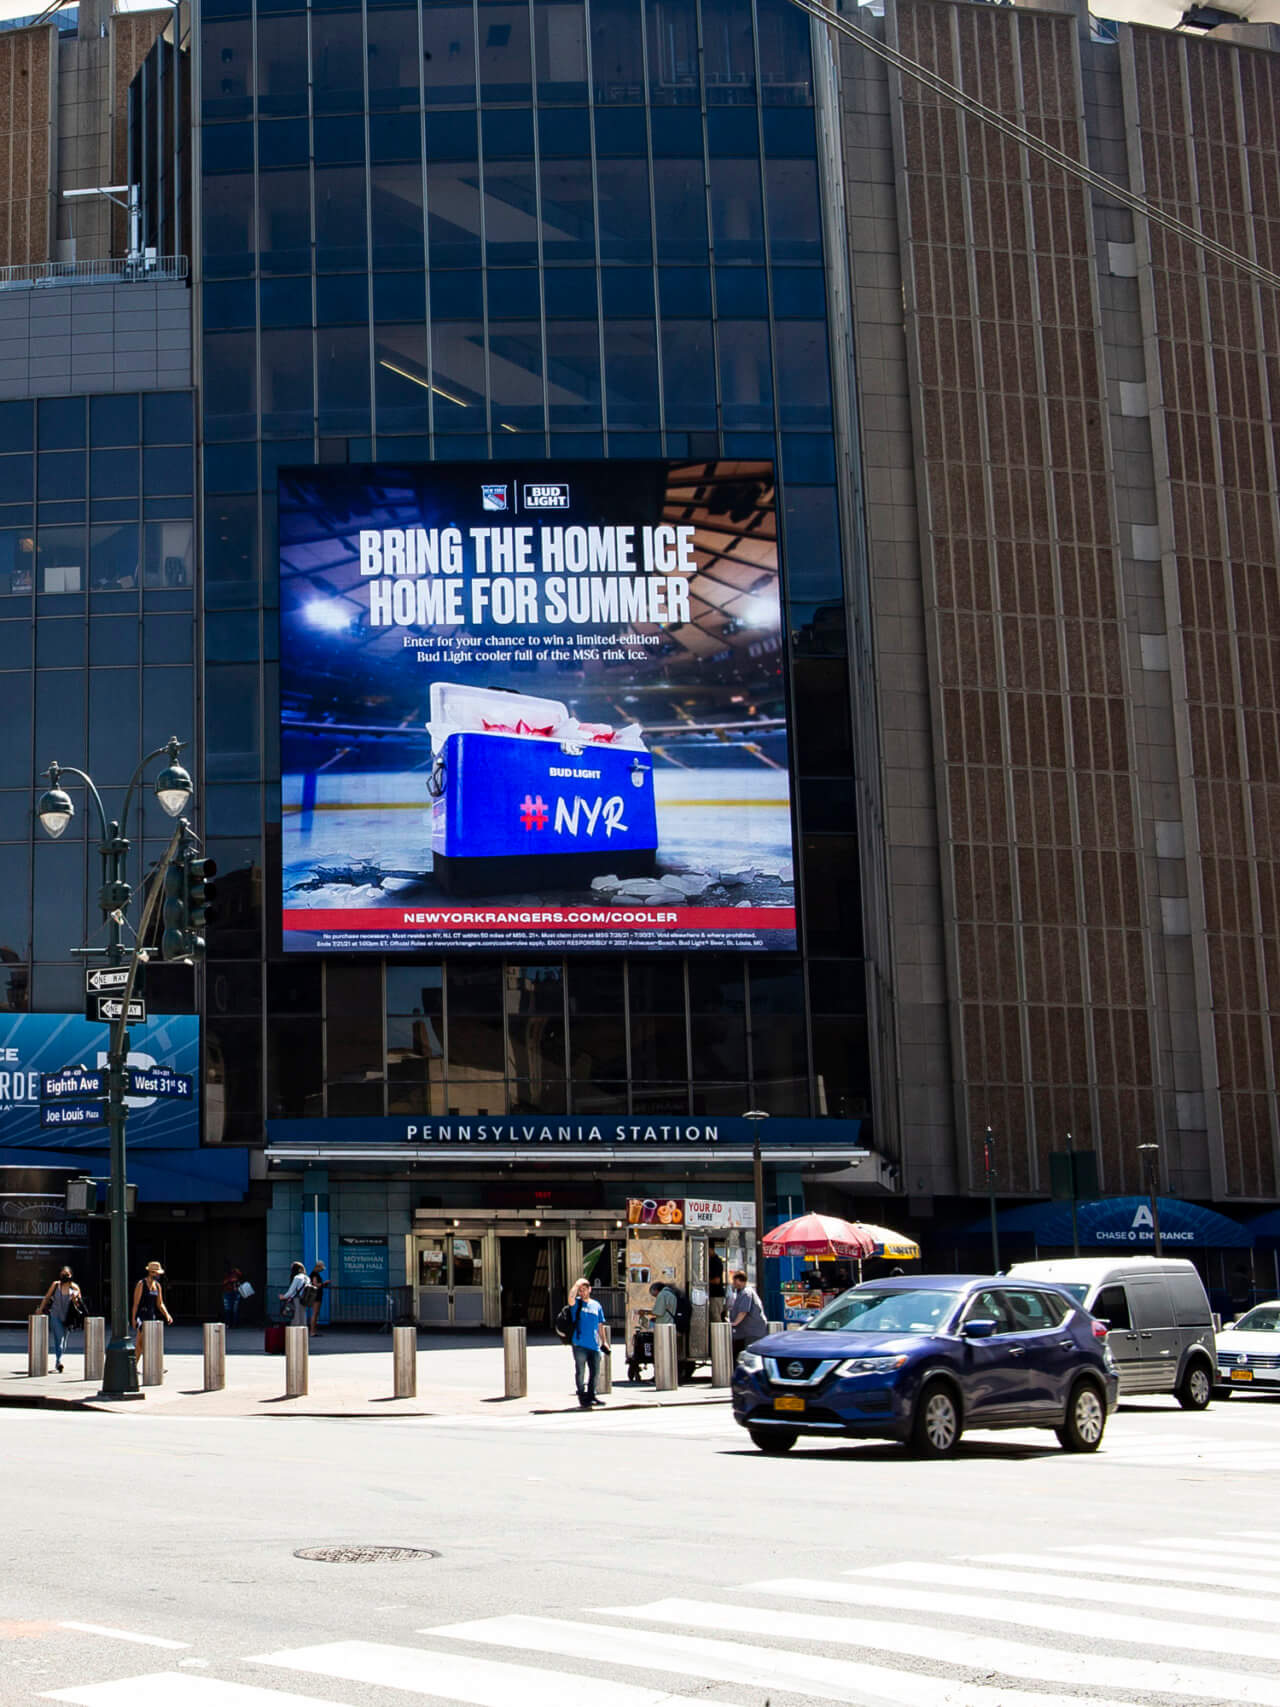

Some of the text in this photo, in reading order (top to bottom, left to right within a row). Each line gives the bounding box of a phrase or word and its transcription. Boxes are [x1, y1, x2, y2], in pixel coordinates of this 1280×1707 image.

[531, 487, 560, 496] BUD
[527, 496, 566, 506] LIGHT
[359, 525, 697, 575] BRING THE HOME ICE
[370, 576, 691, 626] HOME FOR SUMMER
[403, 634, 659, 649] Enter for your chance to win a limited-edition
[417, 648, 647, 664] Bud Light cooler full of the MSG rink ice.
[549, 767, 601, 779] BUD LIGHT
[520, 795, 629, 838] #NYR
[403, 912, 677, 923] NEWYORKRANGERS.COM/COOLER
[94, 975, 107, 984] ONE
[46, 1077, 99, 1095] Eighth Ave
[135, 1076, 158, 1091] West
[177, 1080, 187, 1094] St
[46, 1107, 99, 1122] Joe Louis Plaza
[407, 1125, 718, 1141] PENNSYLVANIA STATION
[688, 1201, 723, 1213] YOUR AD
[698, 1213, 713, 1221] HERE
[1131, 1205, 1154, 1228] A
[1096, 1232, 1194, 1240] CHASE ENRANCE
